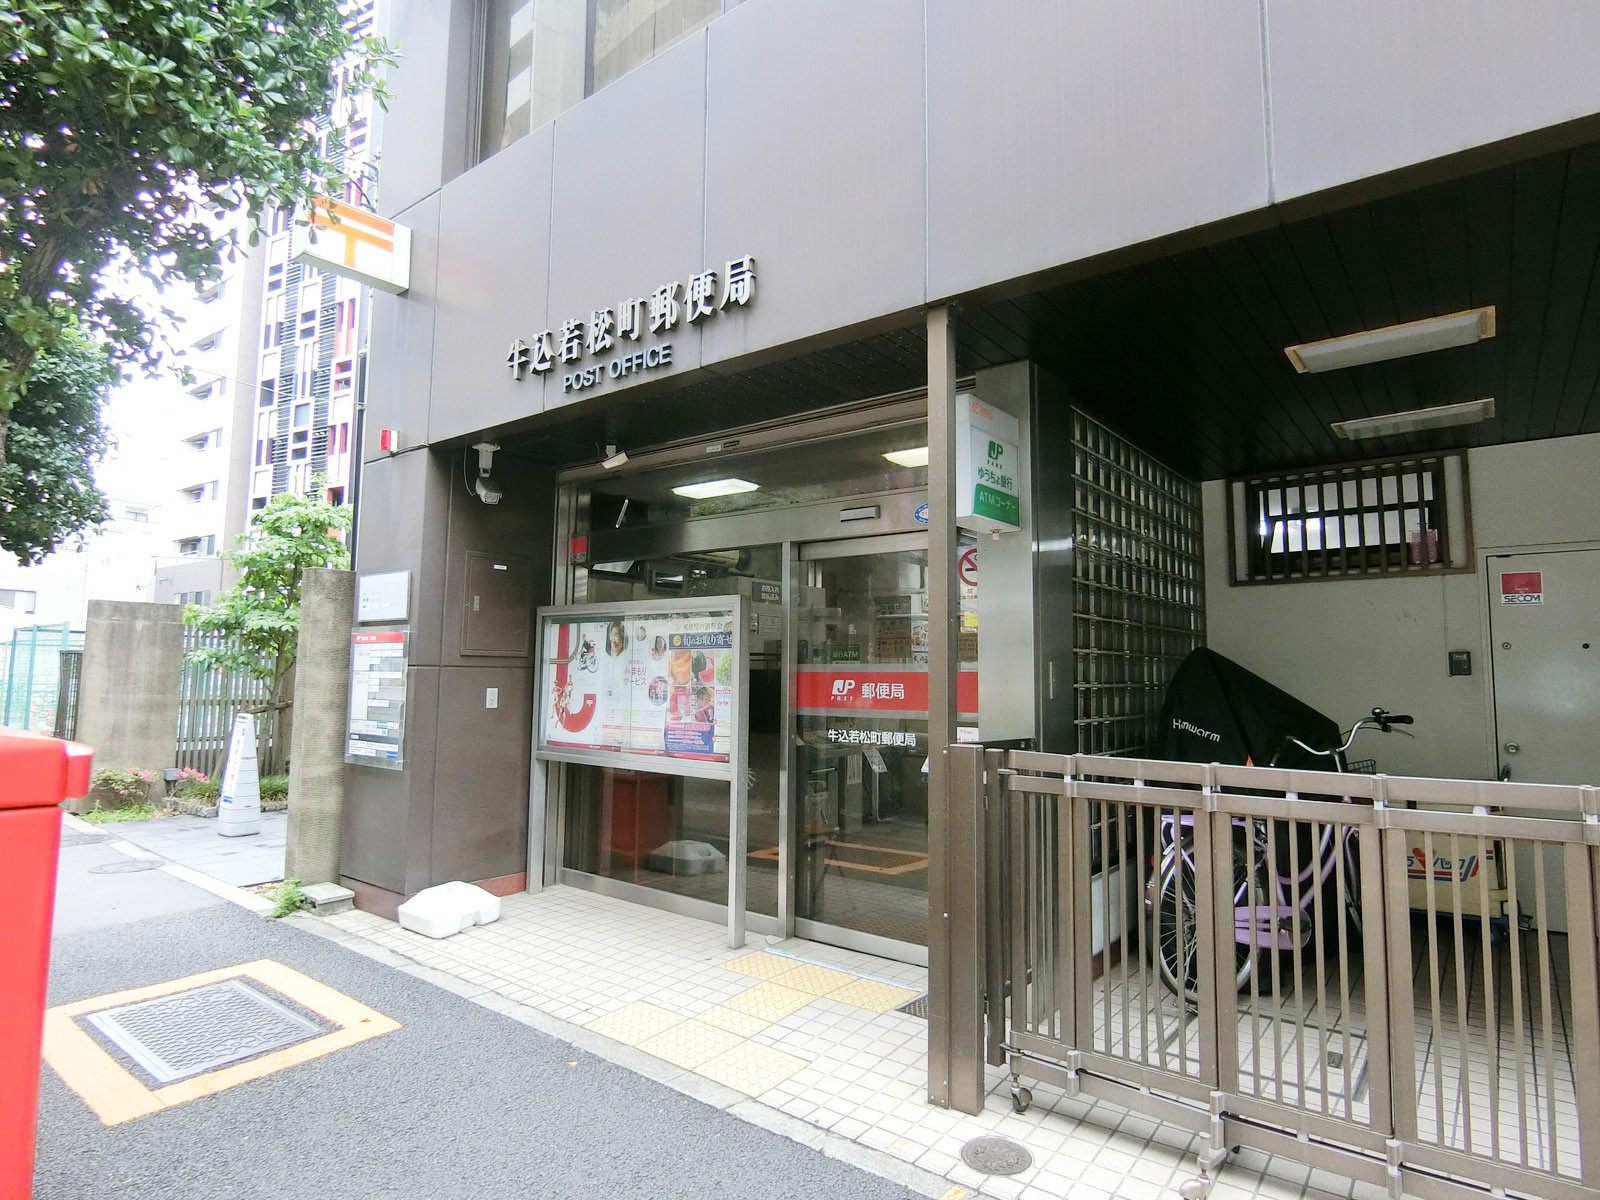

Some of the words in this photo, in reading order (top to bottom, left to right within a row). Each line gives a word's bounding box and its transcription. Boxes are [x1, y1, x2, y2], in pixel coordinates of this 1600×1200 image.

[505, 254, 757, 380] 牛込若松町郵便局
[563, 364, 604, 393] POST
[609, 343, 673, 379] OFFICE
[987, 440, 1003, 460] JP
[977, 467, 1013, 491] ゆうちょ銀行
[979, 491, 1016, 510] ATMコーナー
[1504, 594, 1541, 602] SECOM
[832, 679, 855, 695] JP
[861, 682, 904, 700] 郵便局
[828, 729, 916, 747] 牛込若松町郵便局
